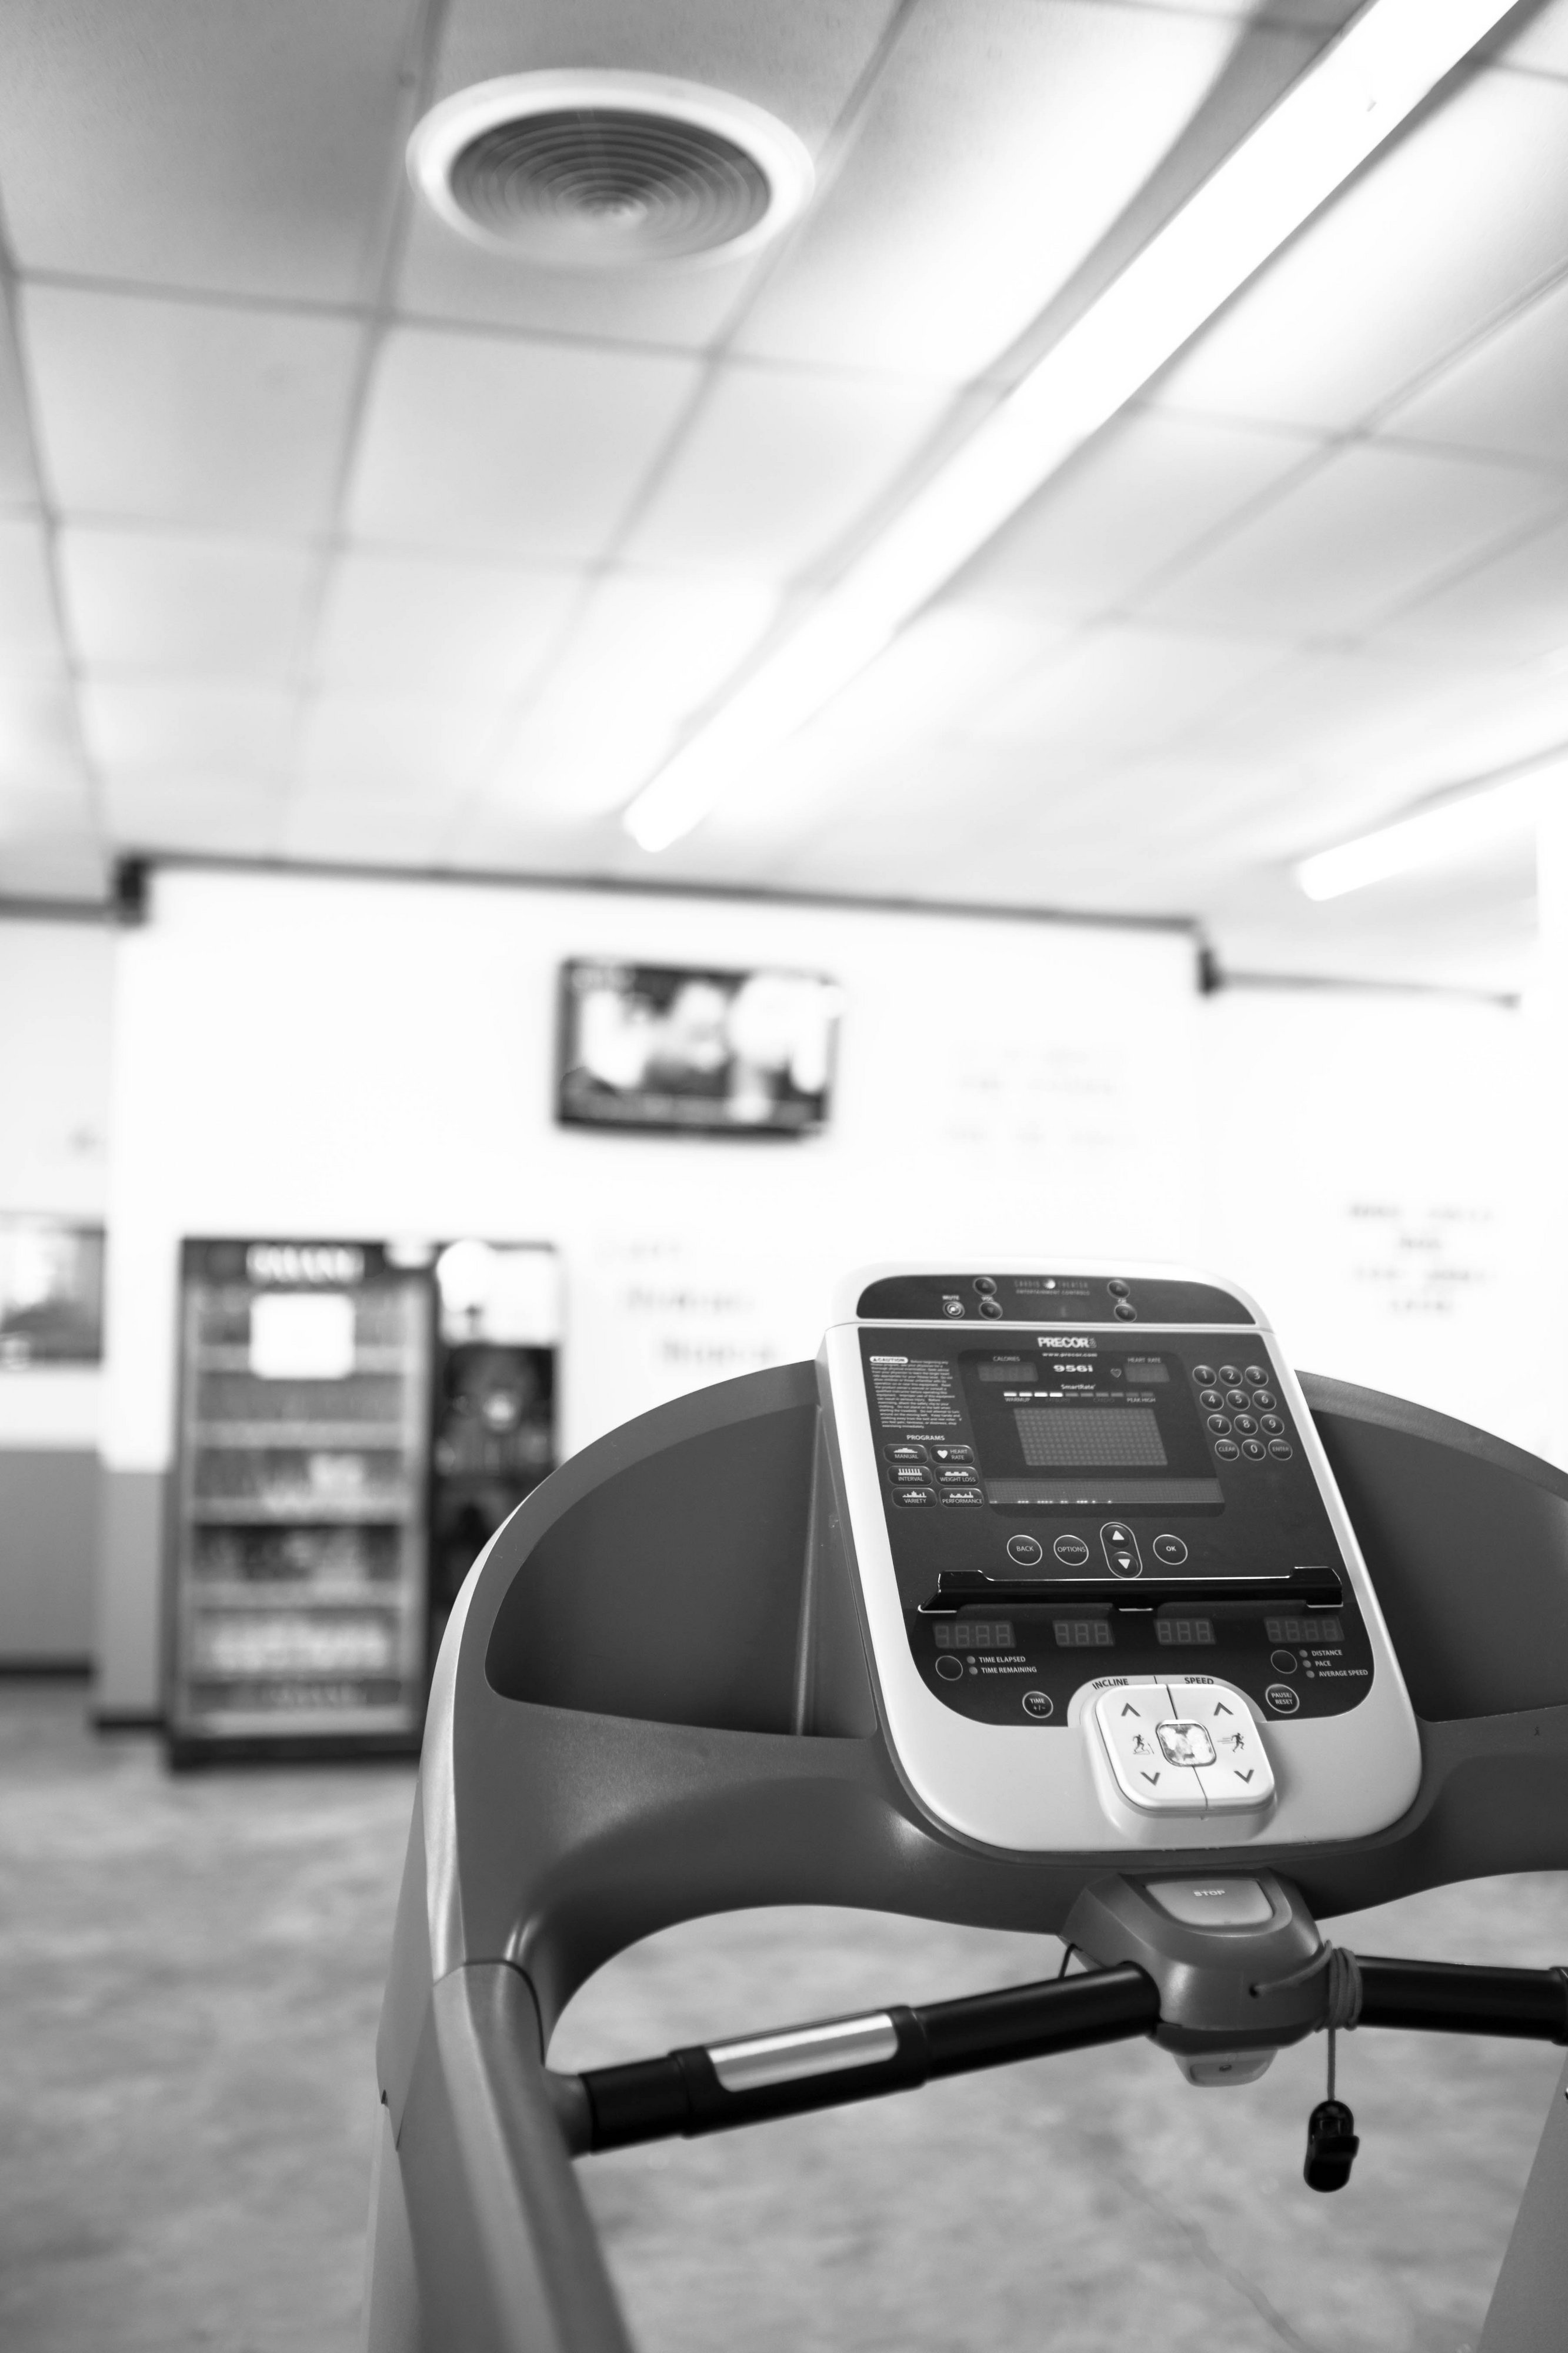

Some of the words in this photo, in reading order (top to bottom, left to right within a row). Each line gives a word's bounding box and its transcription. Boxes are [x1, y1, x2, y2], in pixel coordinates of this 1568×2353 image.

[1037, 1337, 1089, 1348] PRECOR
[1053, 1364, 1093, 1372] 956i
[1202, 1369, 1207, 1379] 1
[1226, 1369, 1235, 1380] 2
[1253, 1369, 1260, 1380] 3
[1208, 1395, 1215, 1404] 4
[1235, 1394, 1242, 1404] 5
[1262, 1395, 1269, 1404] 6
[1215, 1419, 1222, 1428] 7
[1242, 1419, 1250, 1428] 8
[1269, 1419, 1276, 1428] 9
[1250, 1444, 1257, 1454] 0
[1092, 1678, 1129, 1690] INCLINE
[1193, 1889, 1226, 1897] STOP
